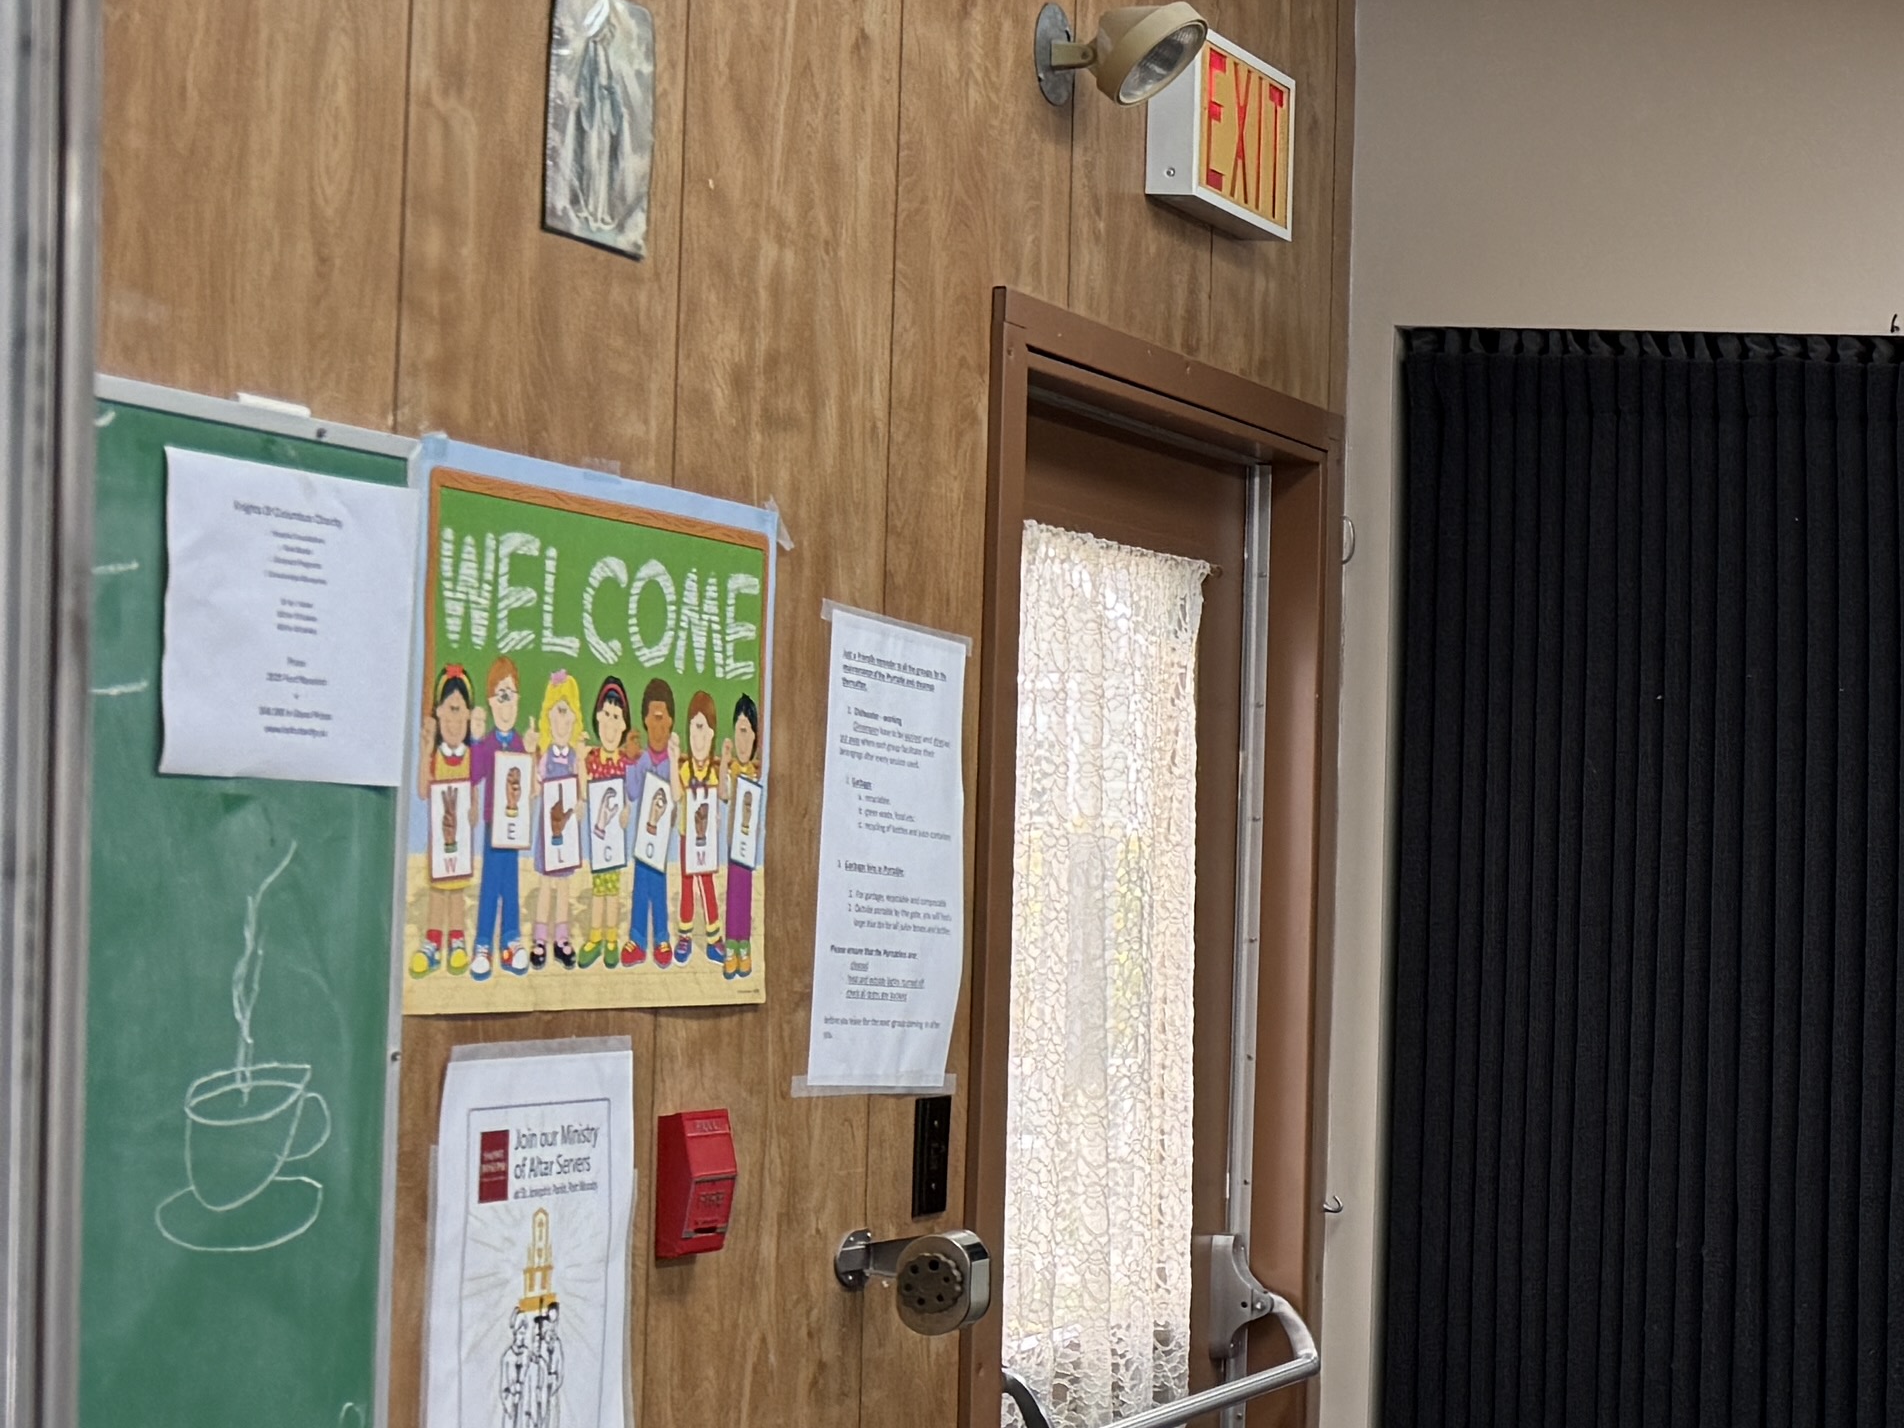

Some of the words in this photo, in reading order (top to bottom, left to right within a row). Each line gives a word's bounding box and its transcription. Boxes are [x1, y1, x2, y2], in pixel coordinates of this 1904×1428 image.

[1206, 48, 1284, 219] EXIT
[441, 527, 760, 680] WELCOME
[507, 822, 516, 841] E
[558, 847, 565, 863] L
[604, 844, 613, 861] C
[646, 841, 654, 859] O
[696, 848, 707, 866] M
[739, 840, 748, 858] E
[444, 856, 458, 874] W
[514, 1127, 537, 1150] Join
[540, 1131, 559, 1147] our
[561, 1124, 600, 1148] Ministry
[514, 1157, 527, 1180] of
[529, 1156, 554, 1179] Altar
[556, 1154, 591, 1175] Servers
